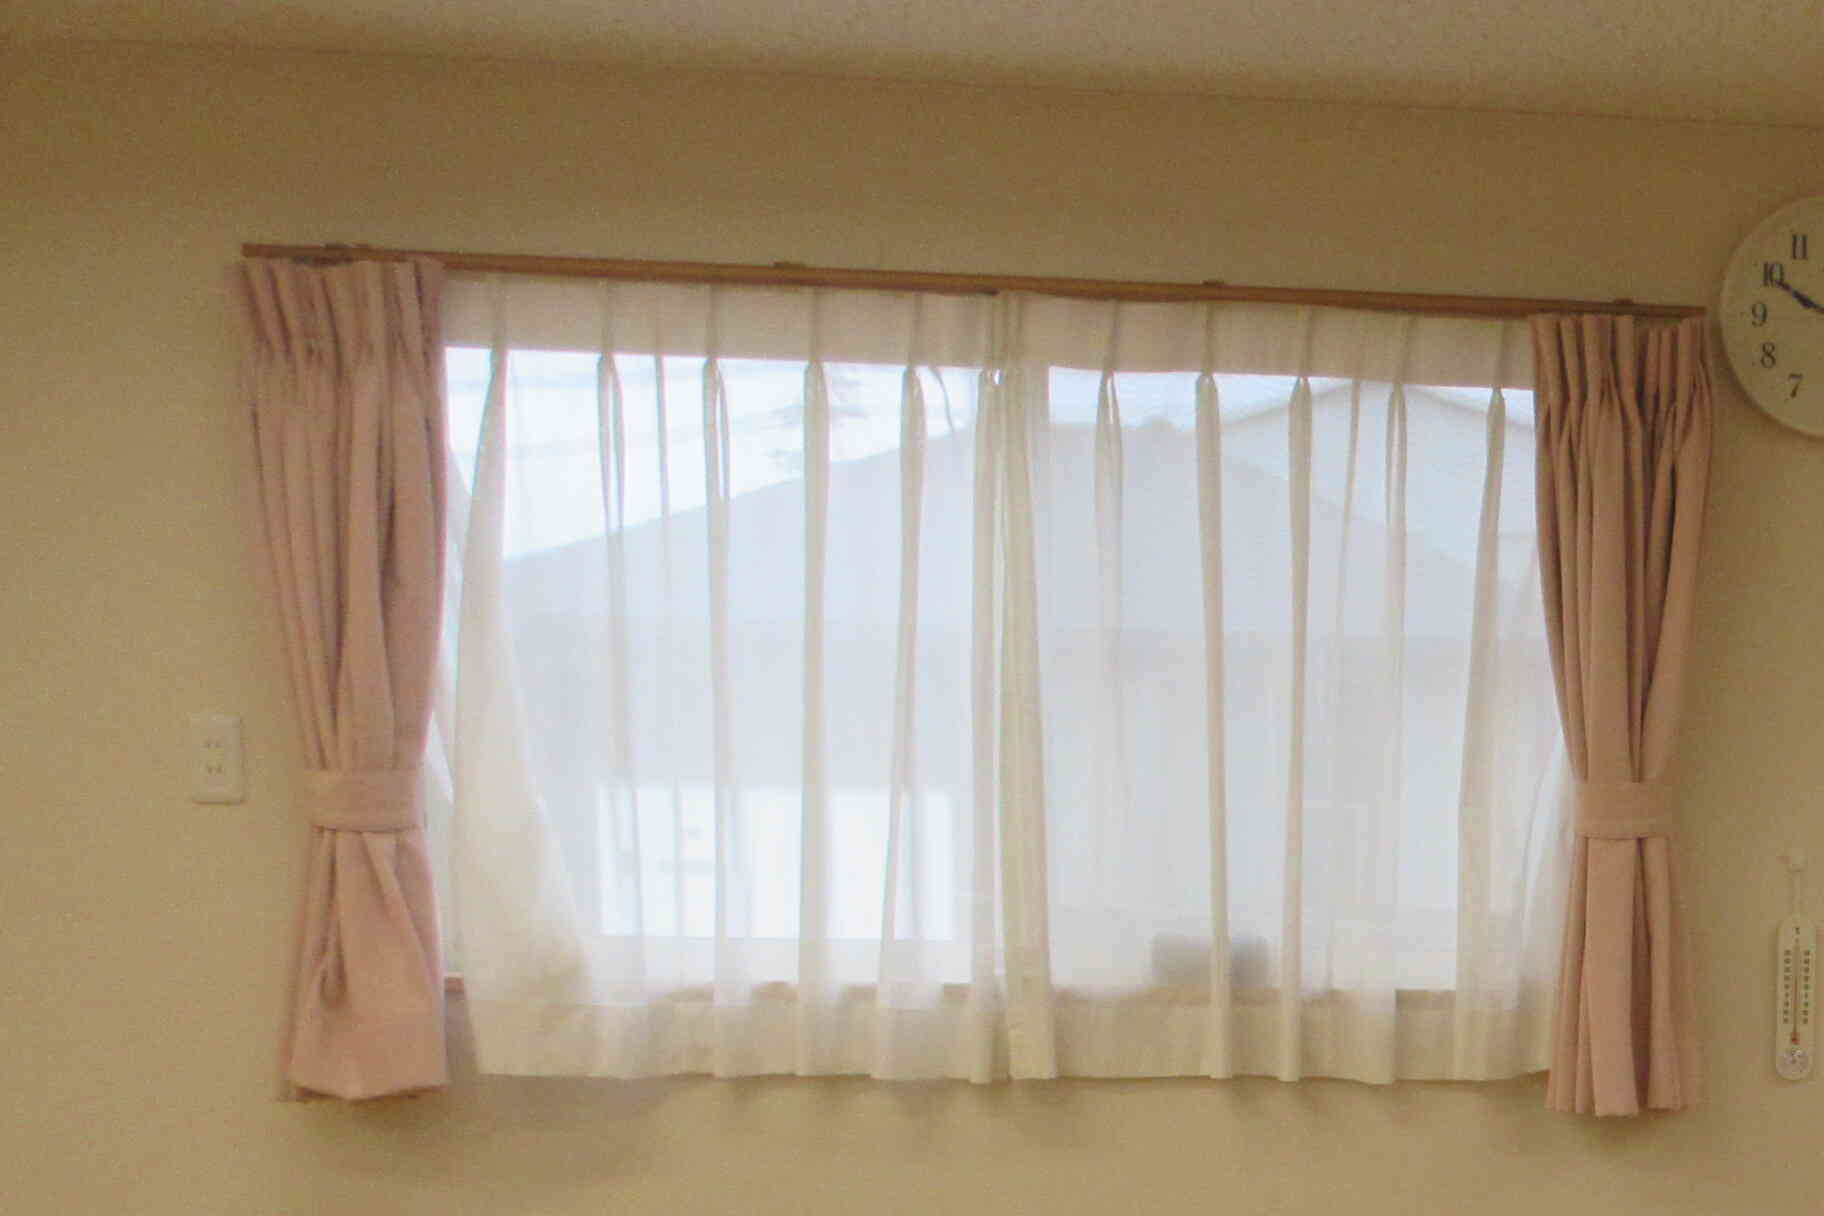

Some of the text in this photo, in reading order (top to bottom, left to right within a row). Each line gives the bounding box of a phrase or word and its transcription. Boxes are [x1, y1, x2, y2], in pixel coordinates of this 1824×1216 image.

[1792, 234, 1807, 260] 11
[1763, 261, 1784, 287] 10
[1751, 302, 1767, 327] 9
[1760, 342, 1776, 368] 8
[1788, 373, 1802, 398] 7
